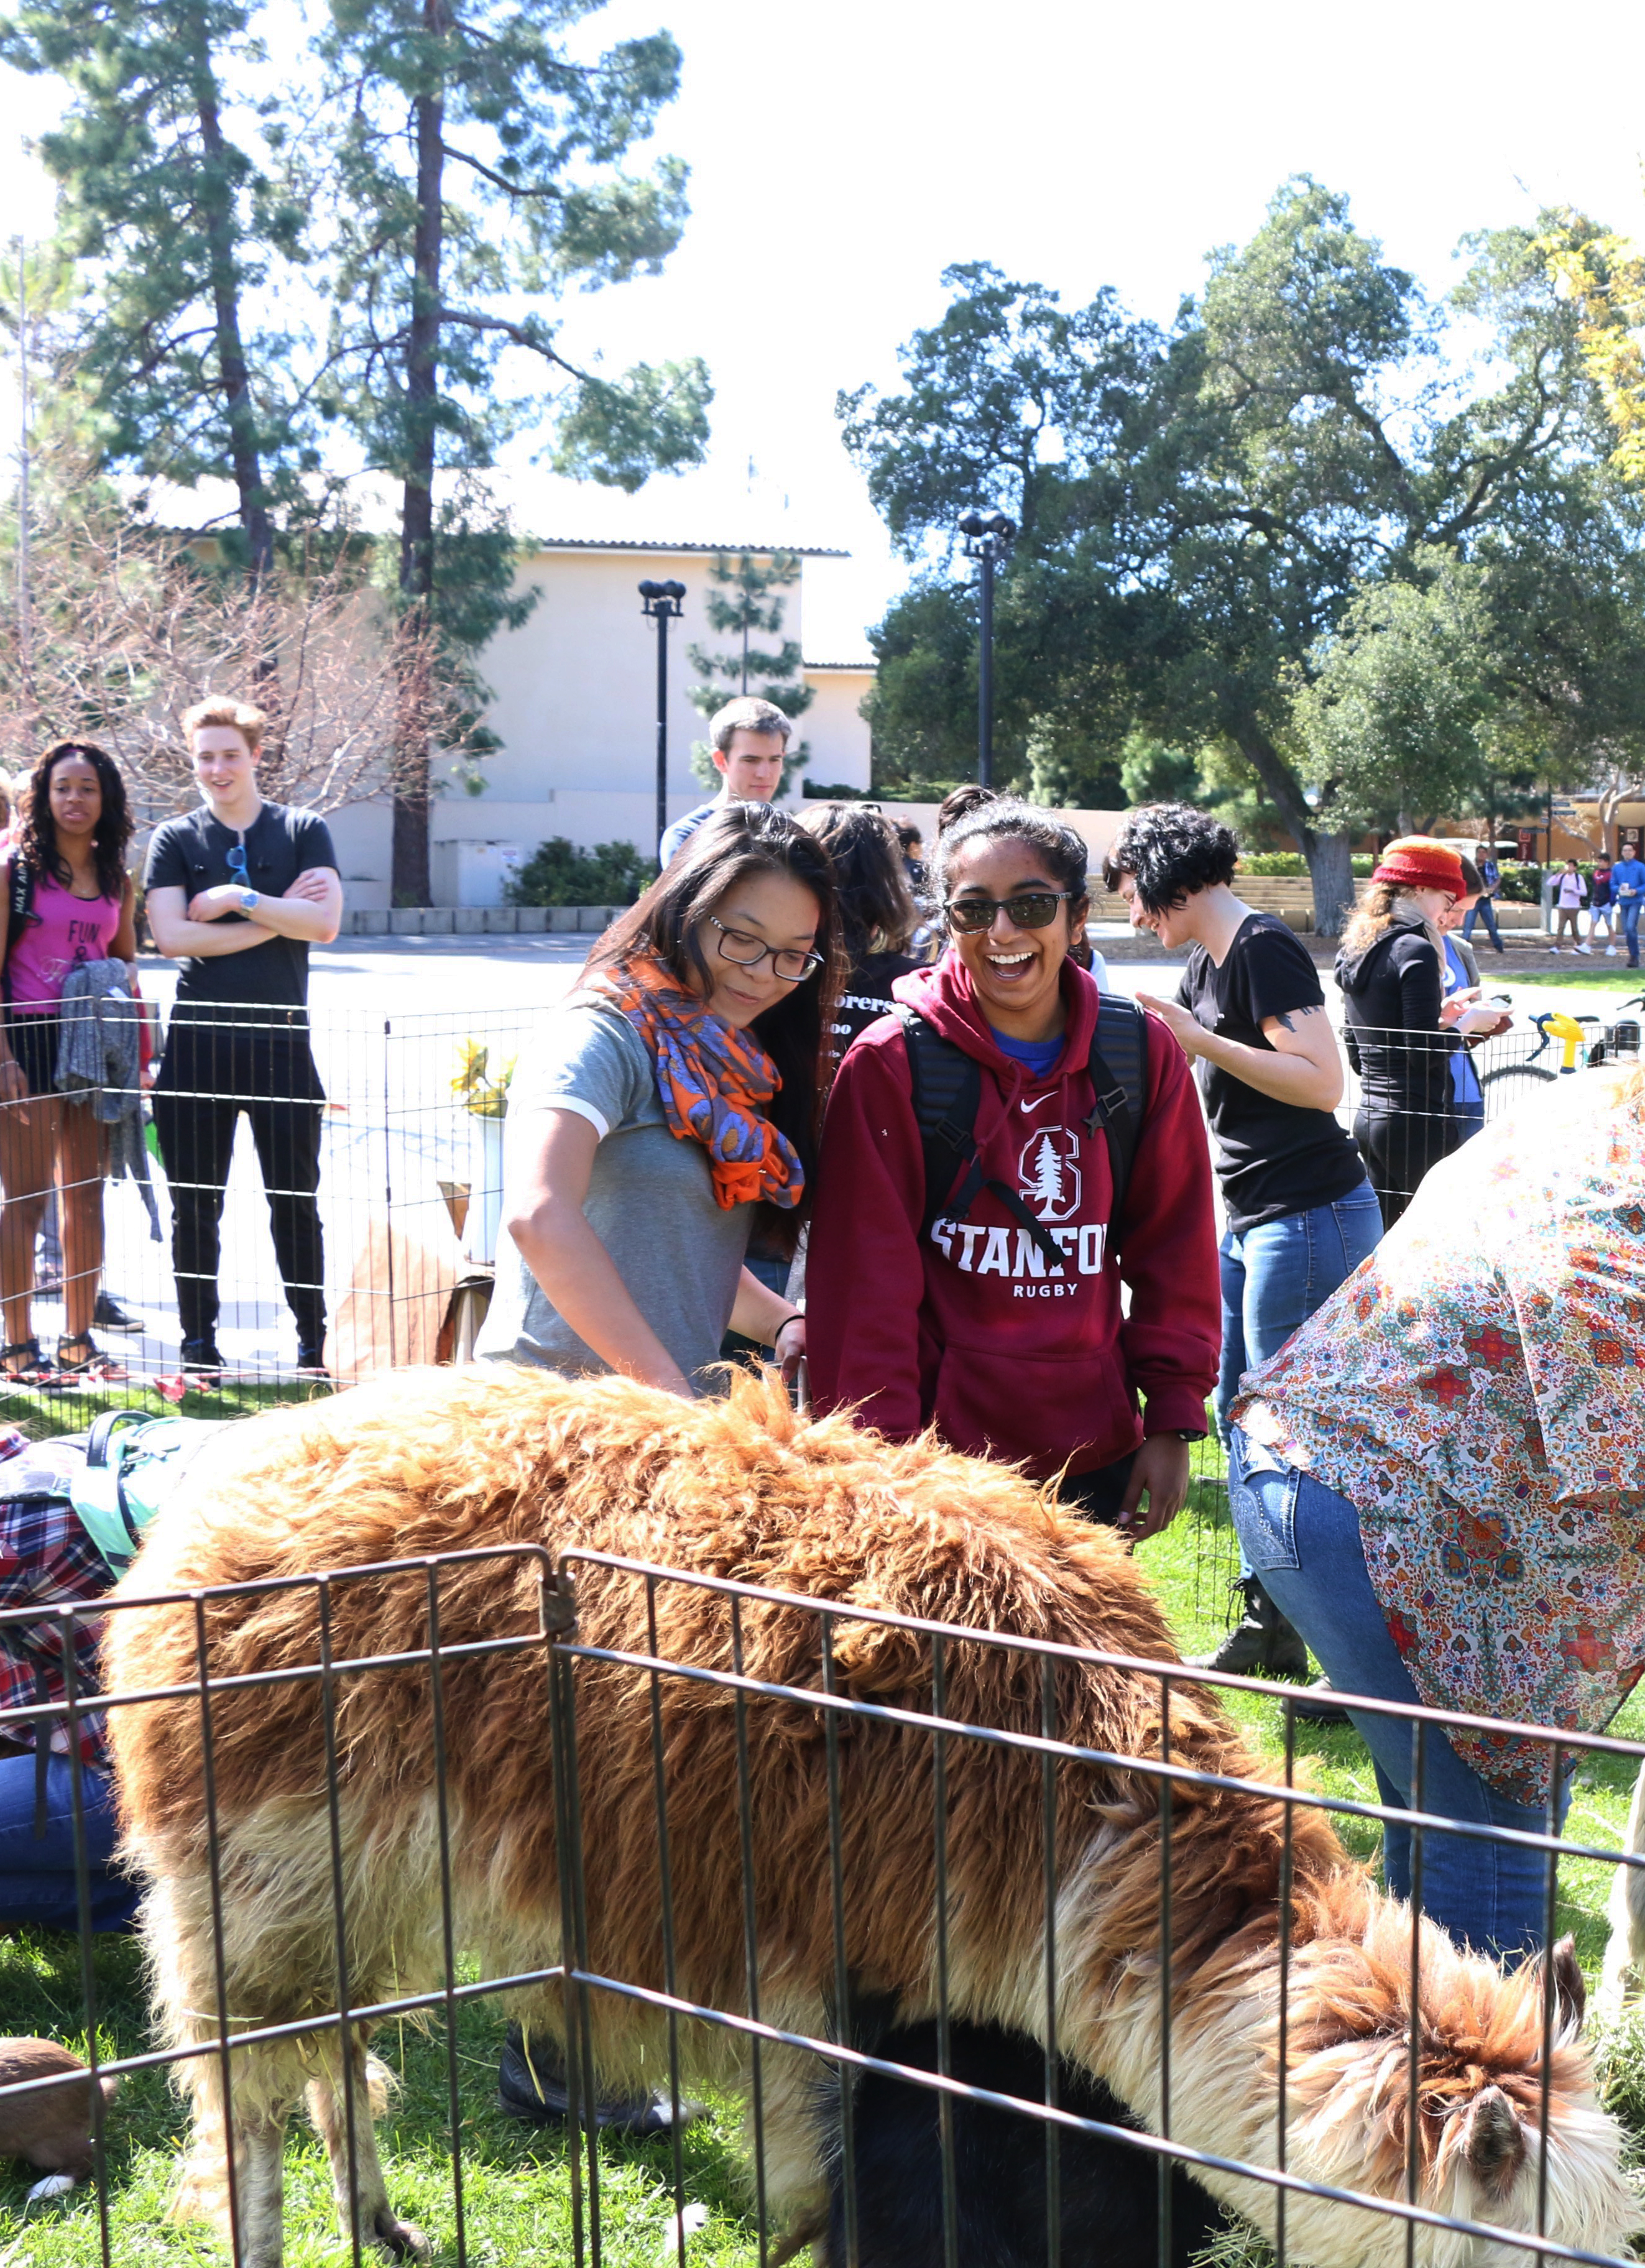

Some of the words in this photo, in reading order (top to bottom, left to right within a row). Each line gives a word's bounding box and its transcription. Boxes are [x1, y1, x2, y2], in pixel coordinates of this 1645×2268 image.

[14, 887, 26, 914] MAX
[68, 920, 100, 943] FUN
[931, 1218, 1107, 1278] STANFO
[1013, 1283, 1078, 1298] RUGBY
